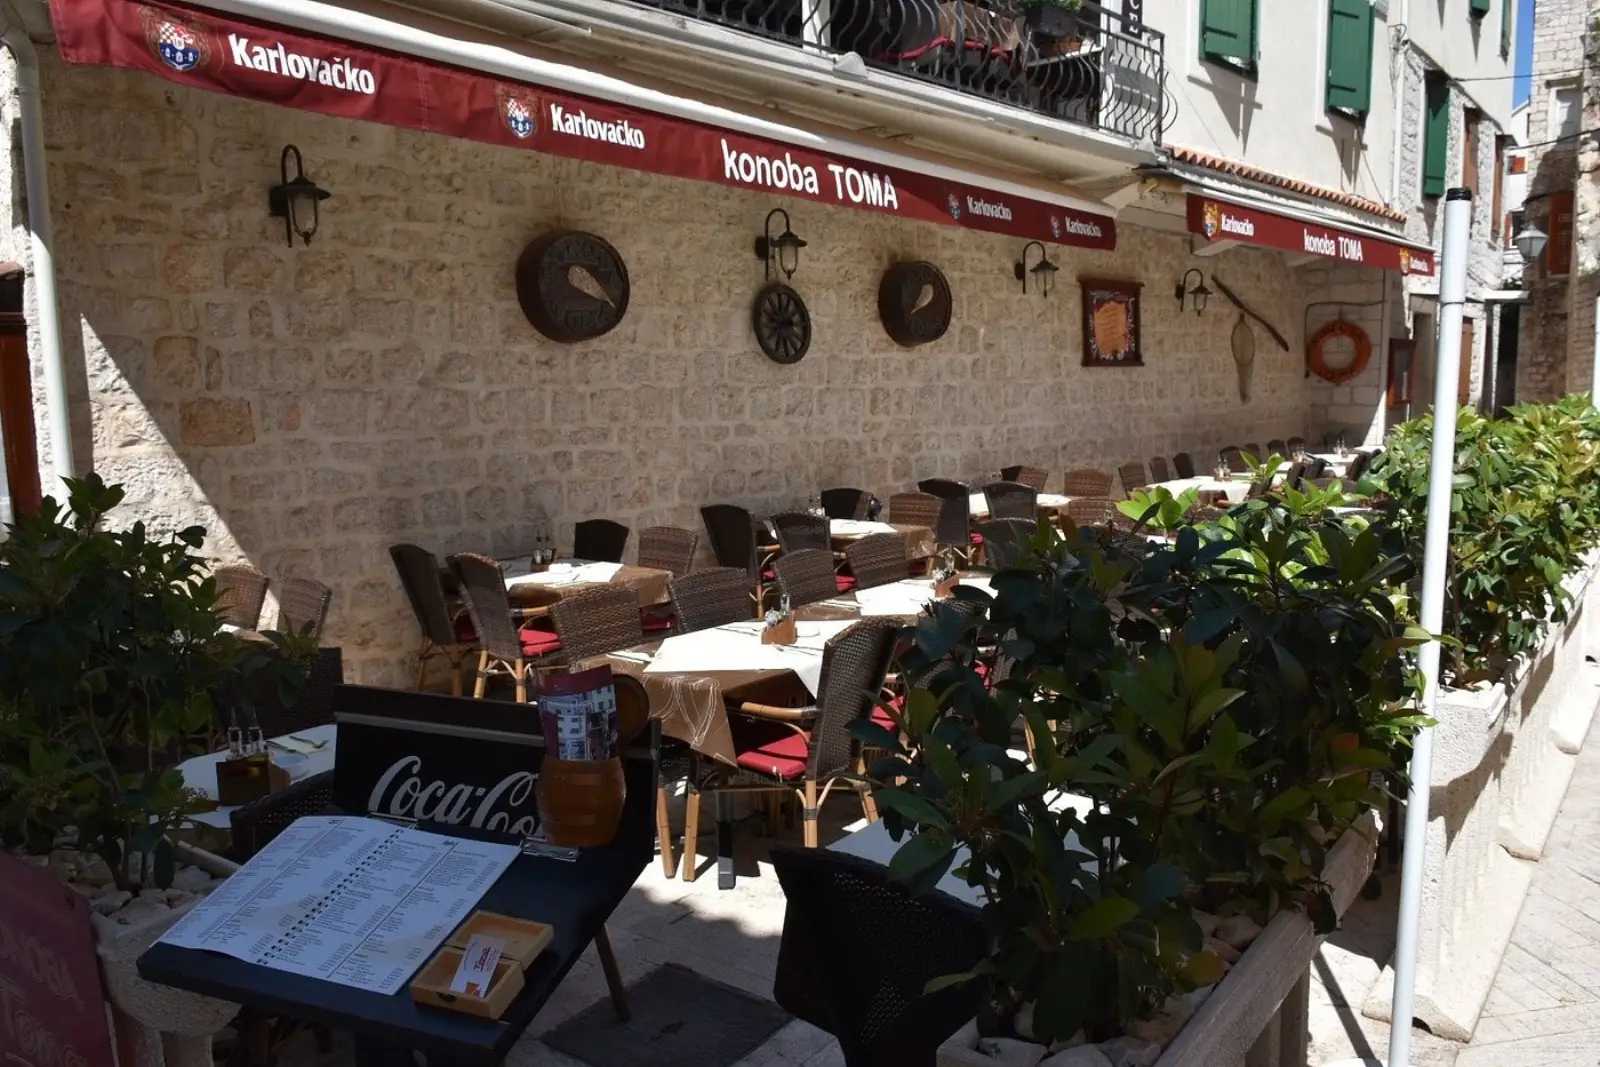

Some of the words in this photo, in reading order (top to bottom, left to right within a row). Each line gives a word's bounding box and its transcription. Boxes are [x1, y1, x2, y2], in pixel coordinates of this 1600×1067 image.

[227, 33, 377, 96] Karlovačko
[549, 102, 646, 150] Karlovačko
[720, 138, 820, 195] konoba
[829, 163, 899, 210] TOMA
[1303, 228, 1336, 257] konoba
[1337, 236, 1364, 263] TOMA
